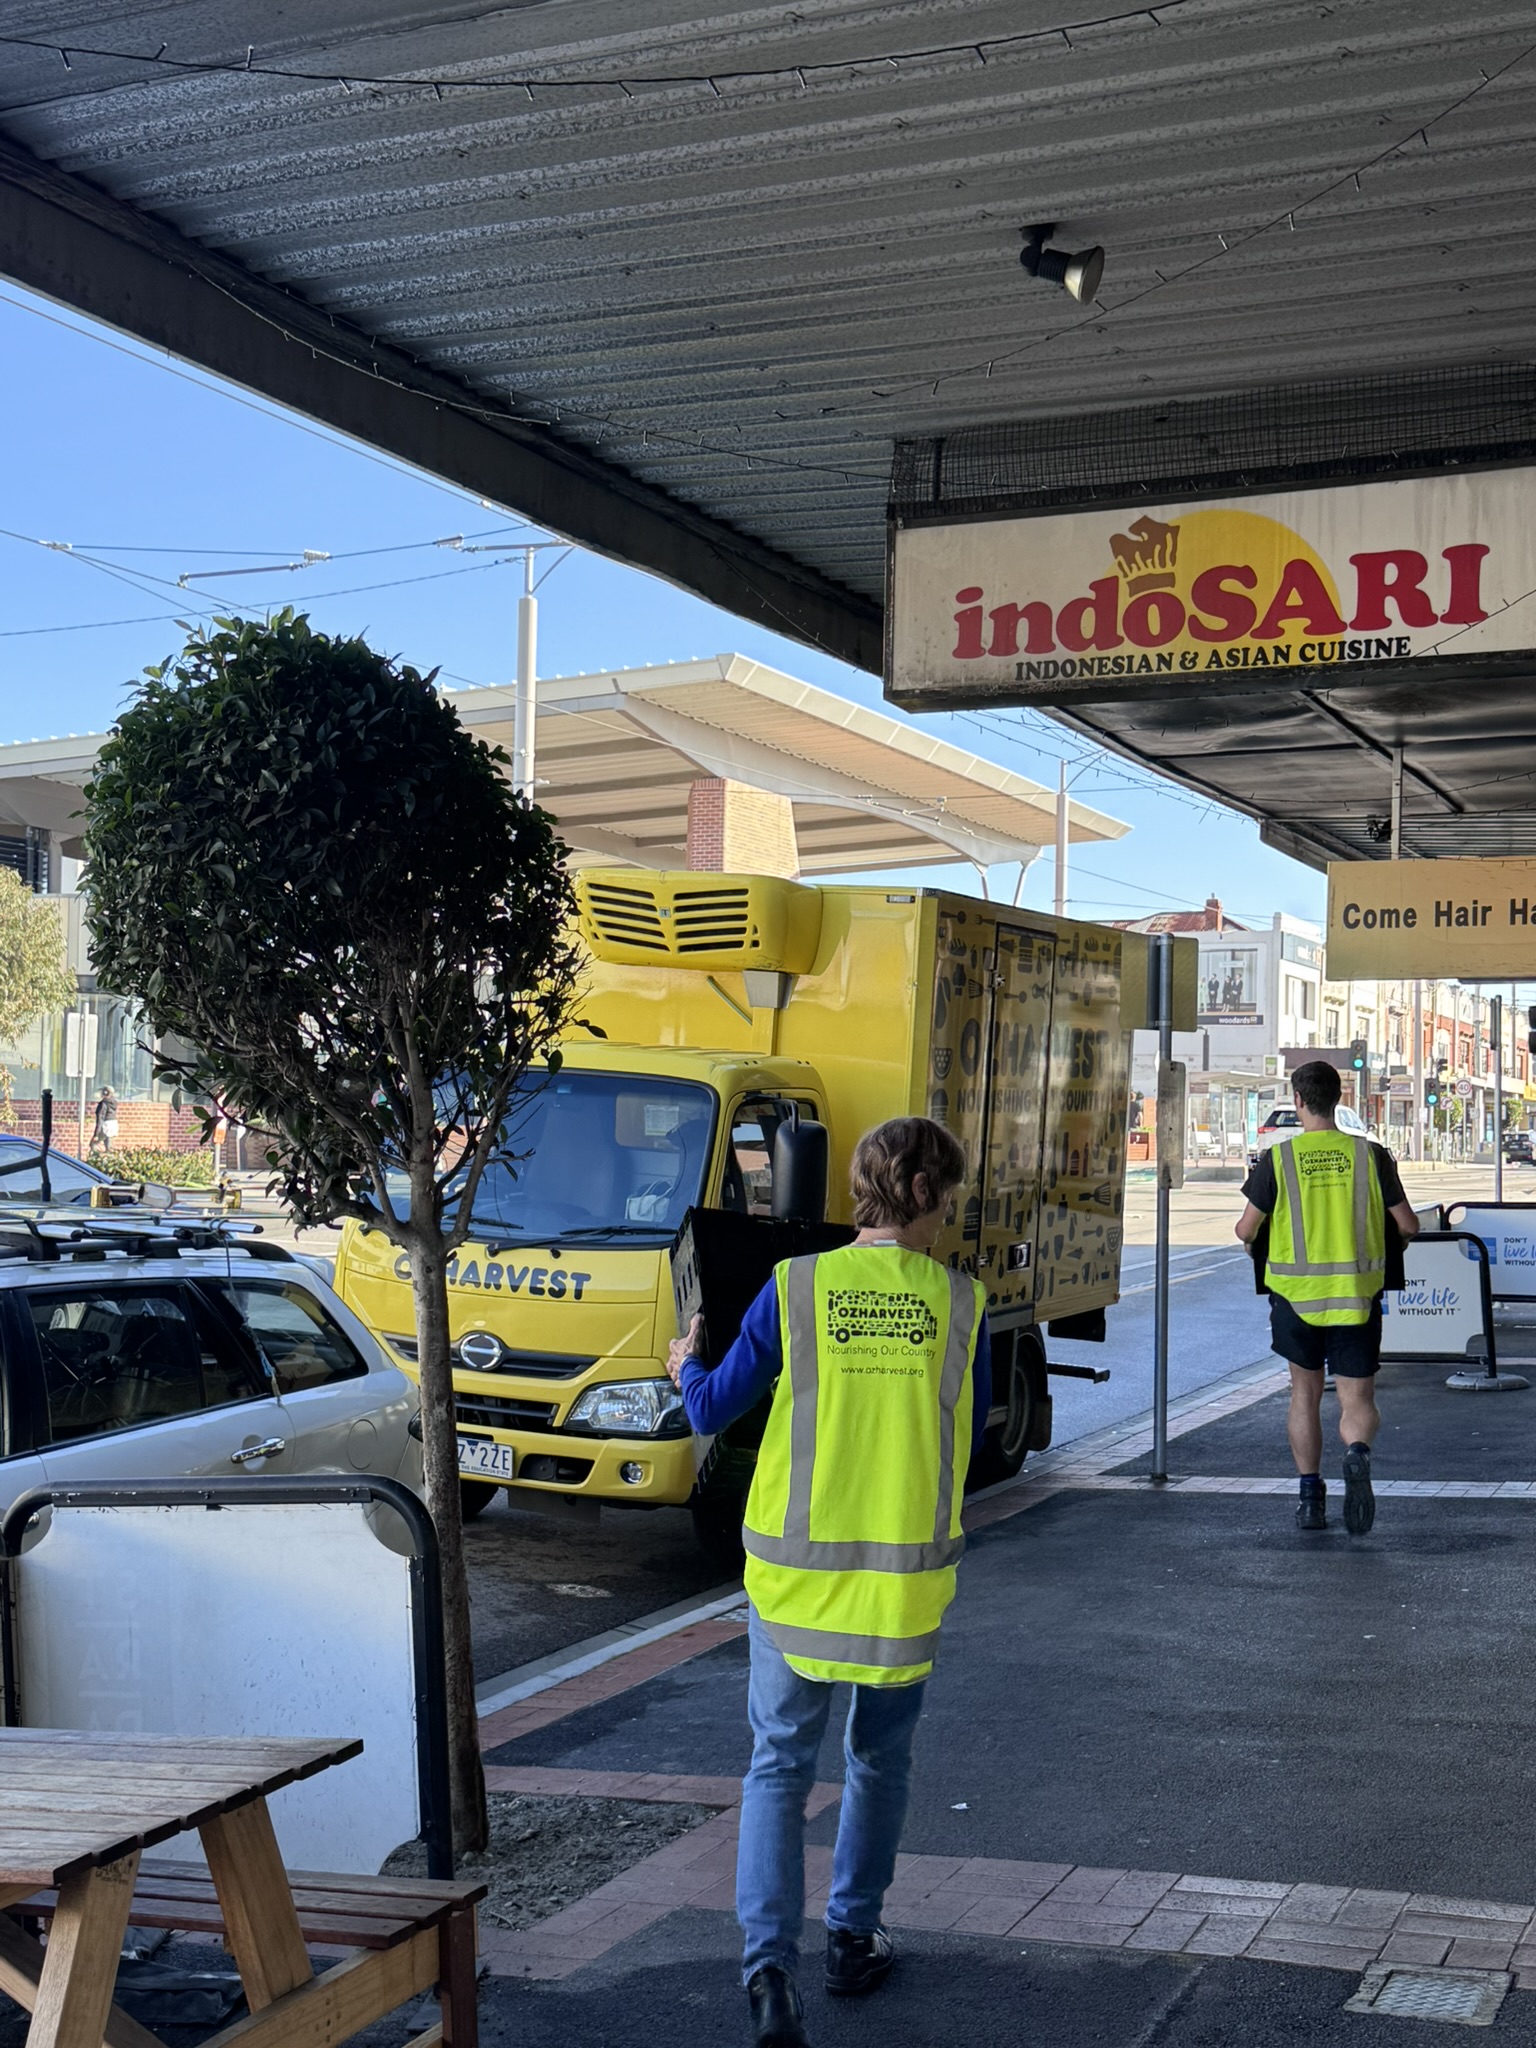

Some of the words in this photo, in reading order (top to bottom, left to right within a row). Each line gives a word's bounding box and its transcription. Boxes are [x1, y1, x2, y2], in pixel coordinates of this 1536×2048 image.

[1015, 652, 1173, 681] INDONESIAN
[1179, 651, 1199, 670] &
[1205, 645, 1292, 669] ASIAN
[1299, 636, 1411, 662] CUISINE
[1343, 903, 1417, 929] Come
[1434, 900, 1492, 927] Hair
[1218, 1016, 1250, 1024] woodards
[1504, 1244, 1528, 1258] live
[394, 1253, 592, 1300] OHARVEST
[1404, 1279, 1427, 1287] ON'T
[1398, 1290, 1429, 1306] live
[1432, 1287, 1460, 1308] life
[838, 1307, 923, 1320] OZHARVEST
[1399, 1308, 1443, 1316] WITHOUT
[827, 1345, 878, 1358] Nourishing
[880, 1345, 899, 1356] Our
[901, 1345, 936, 1360] Country
[840, 1365, 924, 1378] www.ozharvest.org
